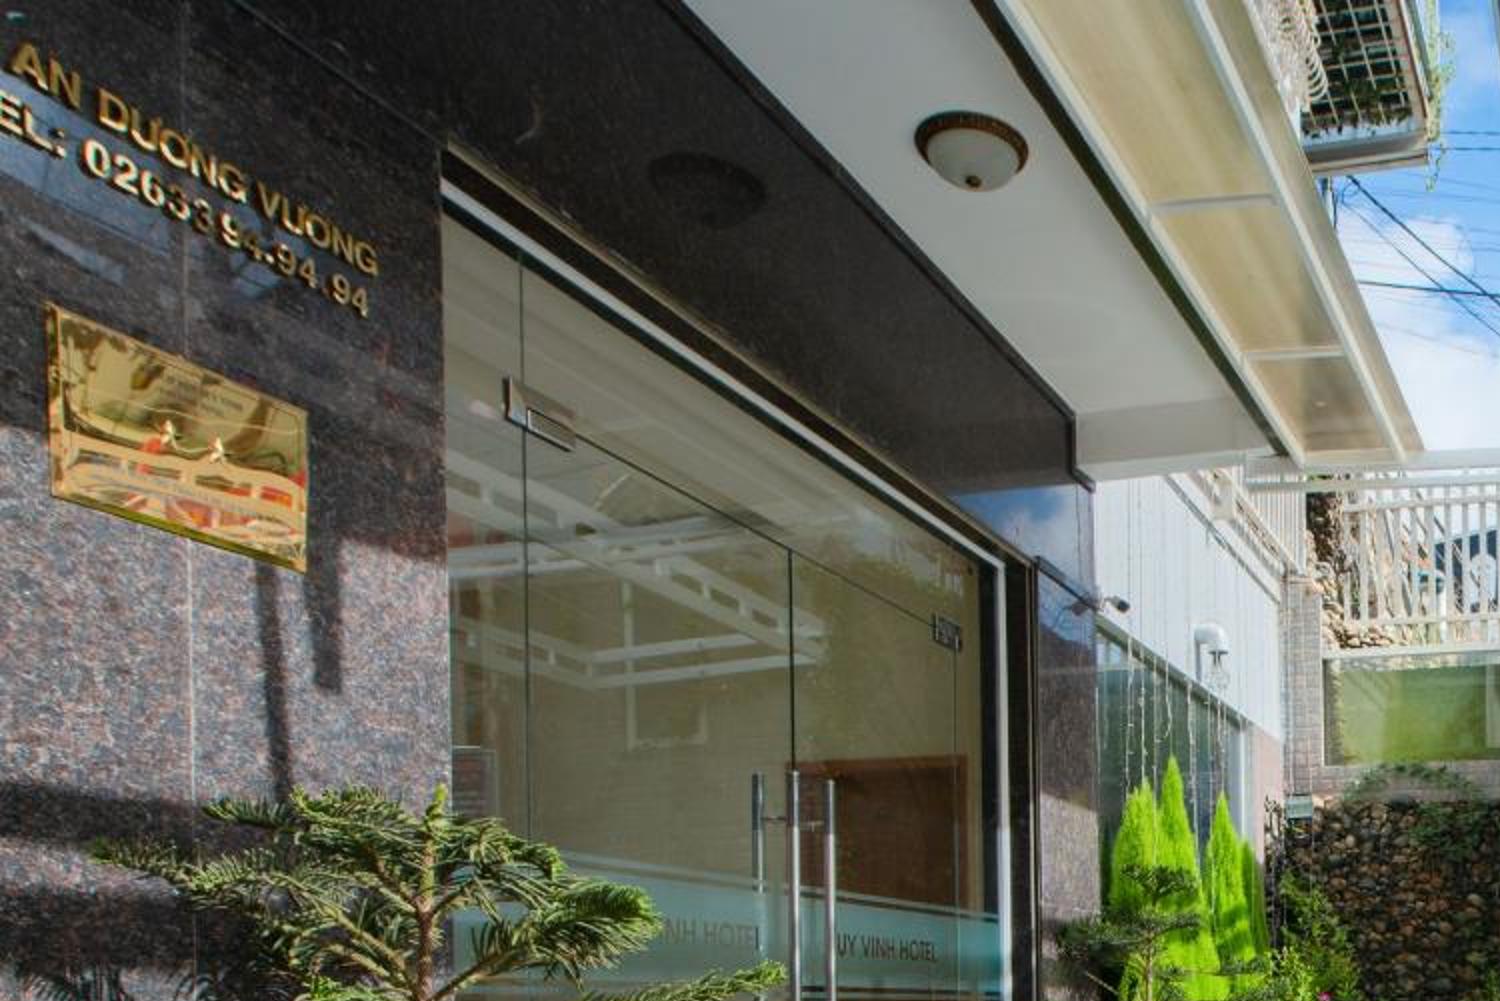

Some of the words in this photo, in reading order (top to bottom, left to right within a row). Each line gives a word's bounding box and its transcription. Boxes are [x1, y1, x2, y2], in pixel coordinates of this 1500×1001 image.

[10, 42, 81, 109] AN
[836, 931, 857, 958] UY
[898, 938, 938, 962] HOTEL
